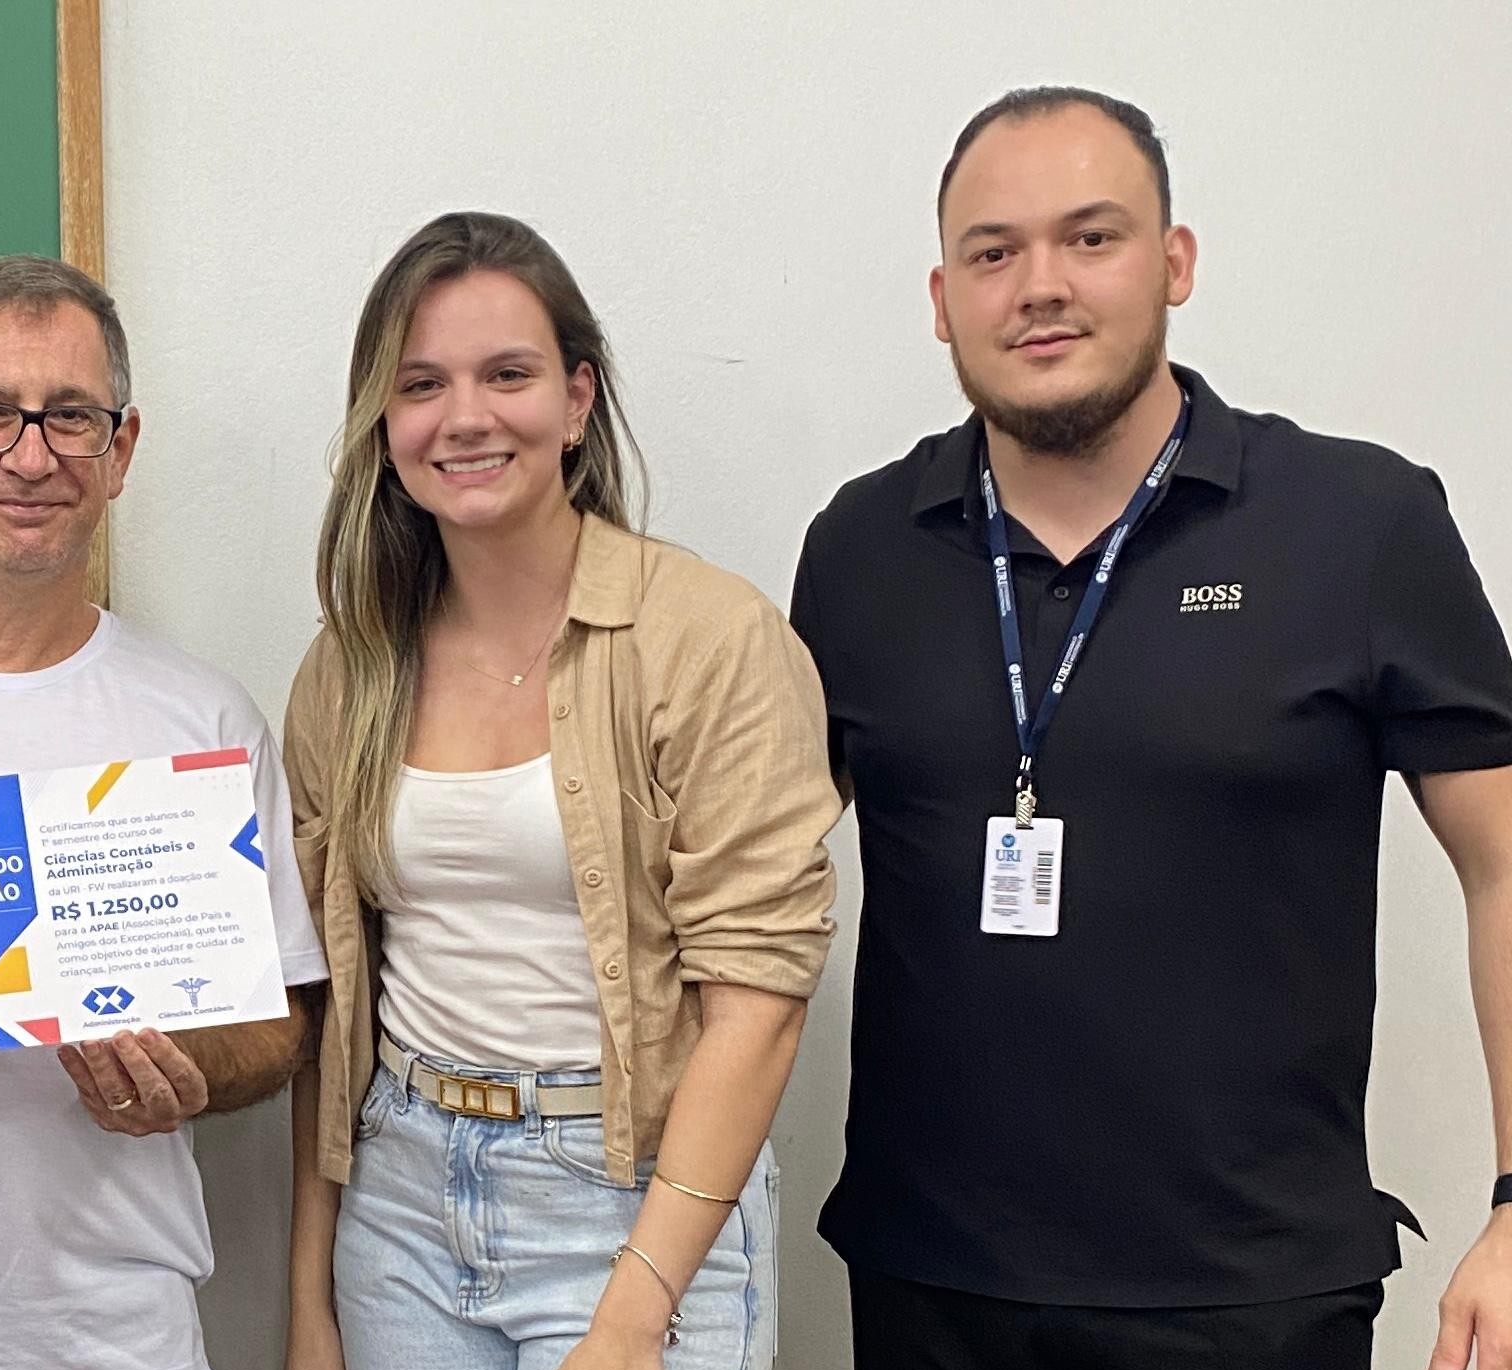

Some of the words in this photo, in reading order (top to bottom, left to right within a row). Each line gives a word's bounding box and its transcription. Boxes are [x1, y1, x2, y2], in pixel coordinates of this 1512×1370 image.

[1099, 551, 1117, 572] URI
[996, 566, 1008, 585] URI
[1181, 583, 1242, 605] BOSS
[1055, 661, 1074, 682] URI
[1011, 674, 1023, 693] URI
[39, 820, 106, 834] Certificamos
[108, 817, 128, 827] que
[130, 816, 142, 824] os
[144, 811, 179, 822] alunos
[180, 808, 195, 818] do
[52, 833, 100, 846] semestre
[102, 831, 117, 841] do
[118, 828, 147, 839] curso
[149, 826, 163, 836] de
[44, 849, 106, 866] Ciências
[109, 840, 183, 858] Contábeis
[186, 841, 195, 850] e
[995, 849, 1022, 862] URI
[46, 859, 153, 880] Administração
[49, 886, 61, 897] da
[63, 885, 81, 895] URI
[88, 882, 105, 892] FW
[107, 877, 157, 890] realizaram
[167, 872, 202, 885] doação
[51, 902, 81, 921] R$
[86, 892, 179, 917] 1.250,00
[54, 928, 78, 938] para
[89, 922, 119, 933] APAE
[121, 917, 182, 930] (Associação
[185, 914, 198, 922] de
[200, 911, 223, 921] Pais
[56, 940, 96, 951] Amigos
[99, 936, 118, 946] dos
[195, 926, 215, 937] que
[218, 923, 240, 932] tem
[58, 954, 88, 964] como
[90, 949, 133, 964] objetivo
[135, 947, 149, 956] de
[150, 942, 183, 955] ajudar
[186, 942, 193, 950] e
[195, 938, 228, 948] cuidar
[231, 936, 245, 944] de
[108, 962, 141, 975] jovens
[83, 1017, 141, 1028] Administração
[158, 1010, 192, 1020] Ciências
[194, 1005, 234, 1015] Contábeis
